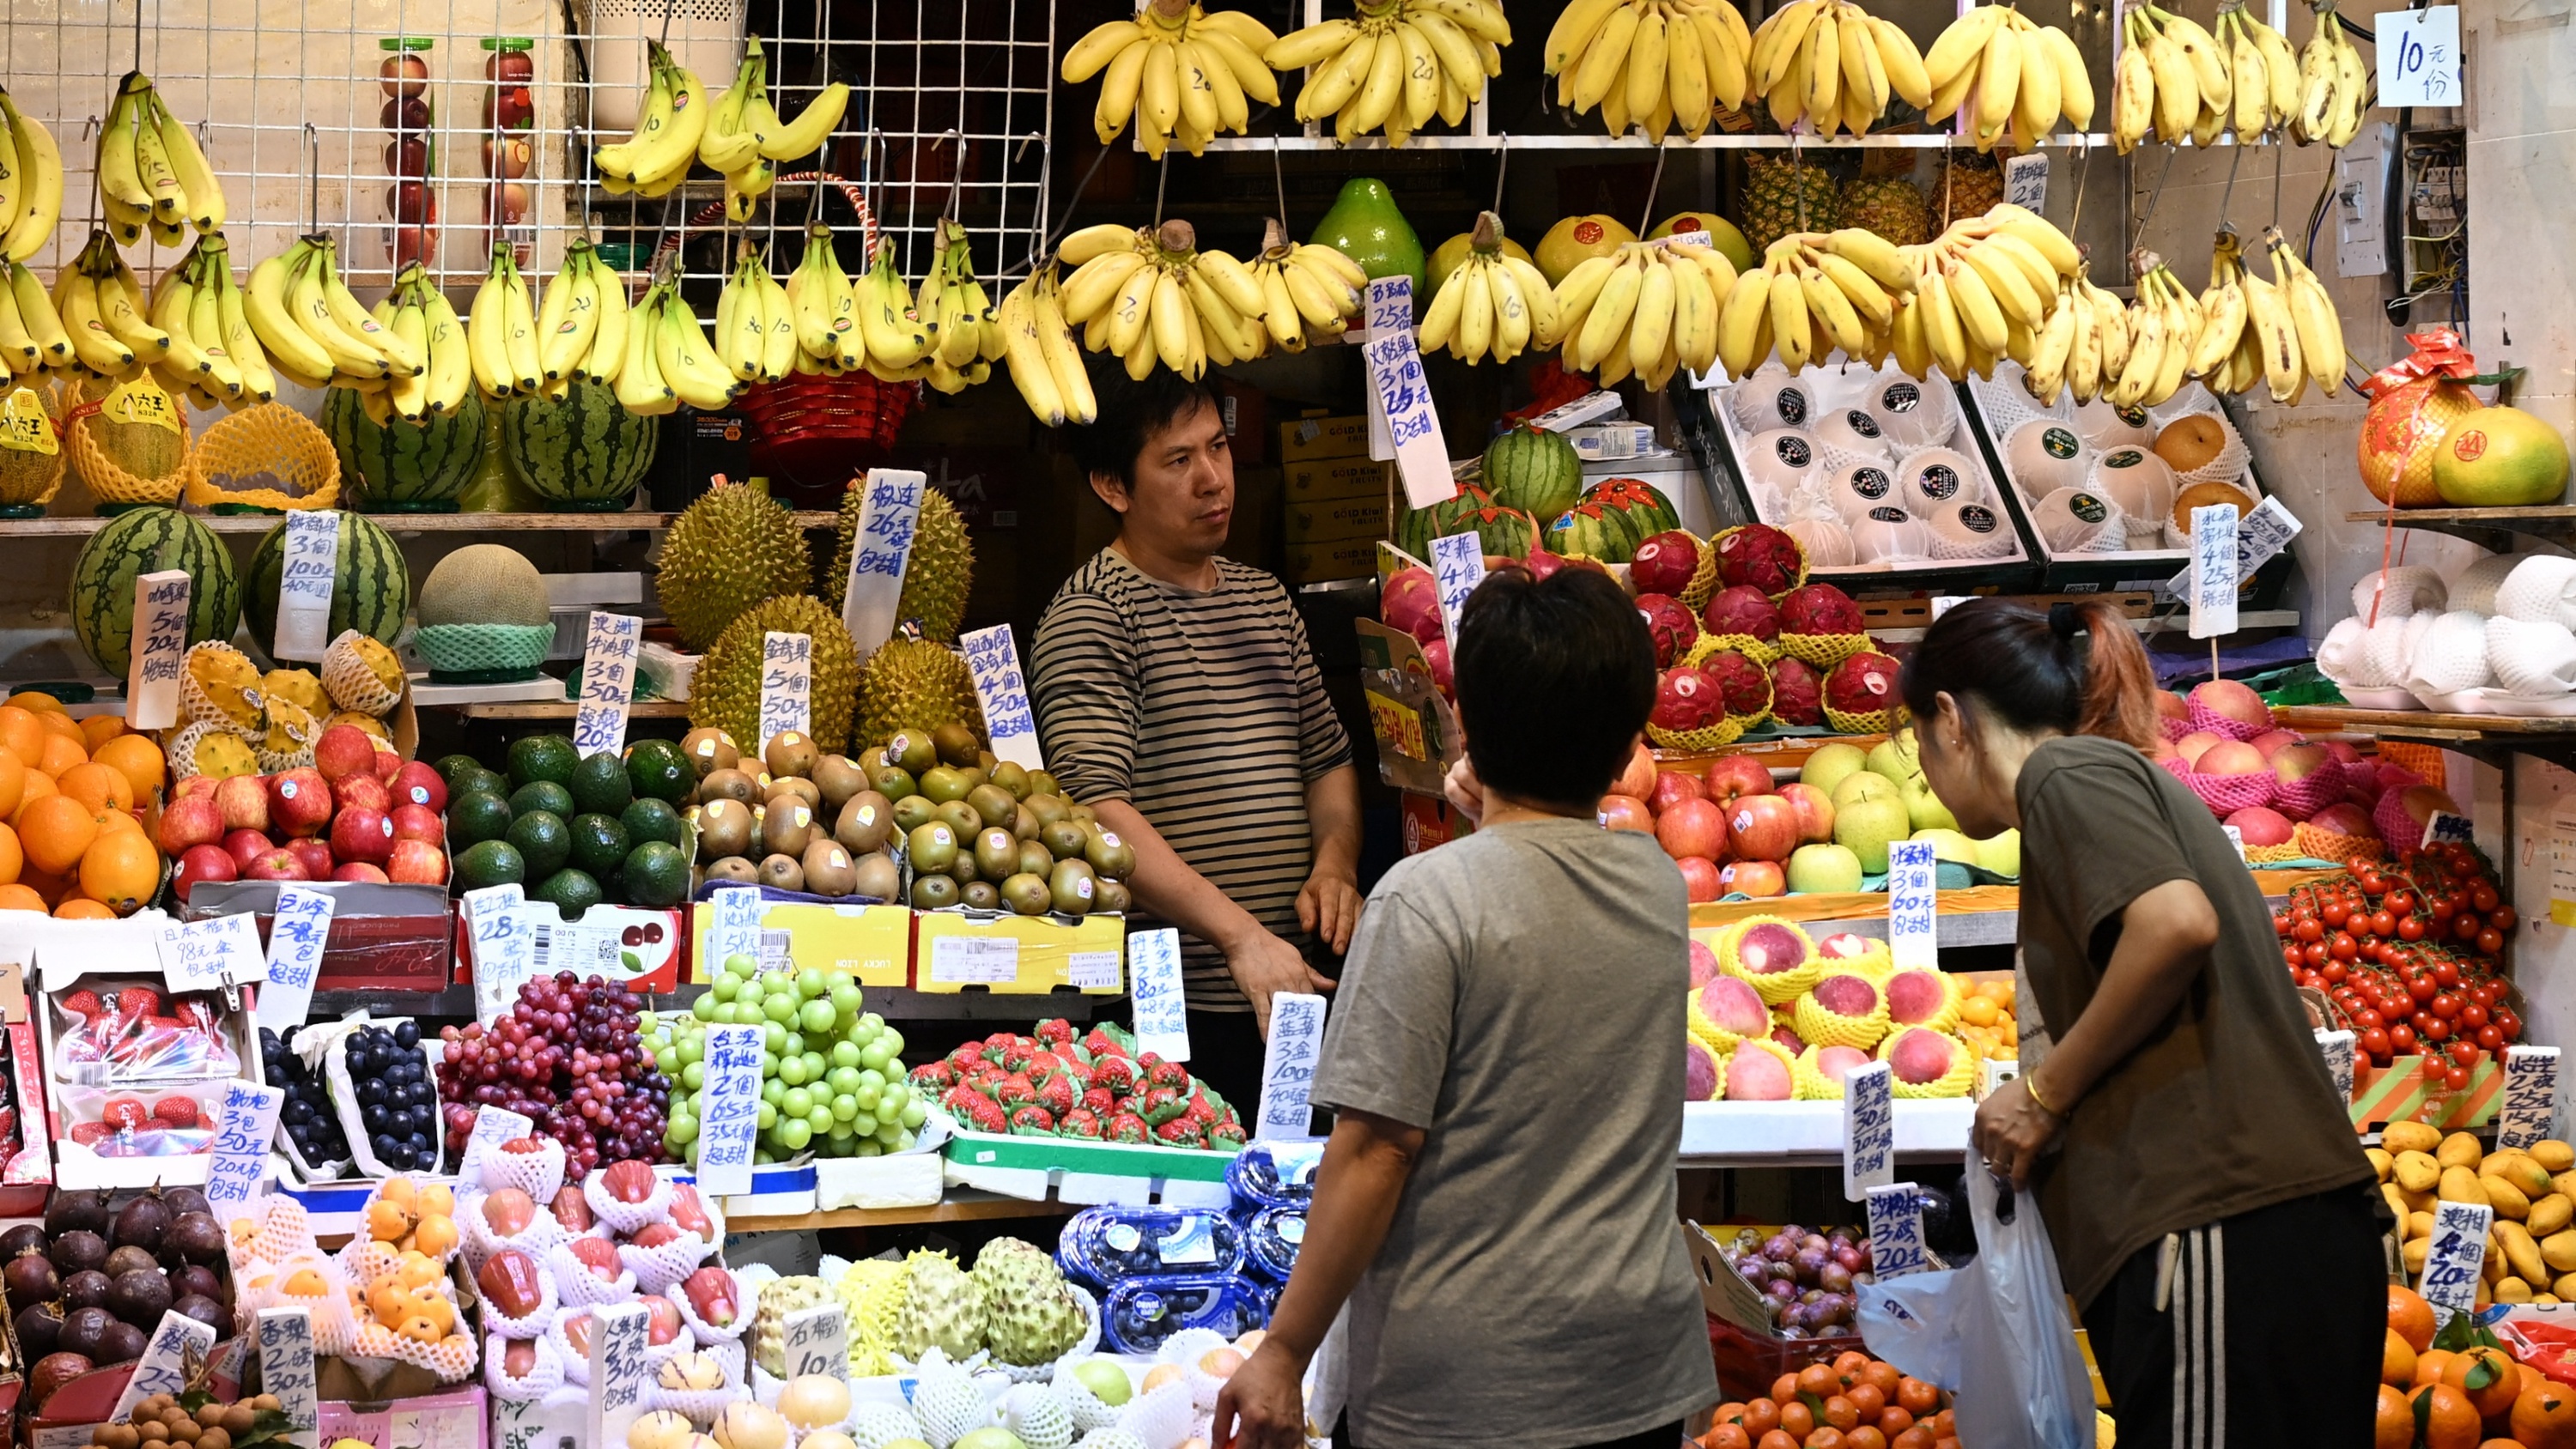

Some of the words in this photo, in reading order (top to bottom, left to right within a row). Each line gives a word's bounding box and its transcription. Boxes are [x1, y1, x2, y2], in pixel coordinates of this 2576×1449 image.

[1411, 55, 1435, 81] 20
[2423, 70, 2451, 101] 份
[643, 112, 660, 134] 10
[114, 299, 133, 318] 13
[1116, 296, 1137, 324] 20
[432, 320, 451, 343] 15
[771, 317, 791, 334] 10
[677, 346, 696, 368] 10
[1376, 358, 1422, 392] 3個
[289, 535, 332, 556] 3個
[2201, 543, 2235, 567] 4個
[1440, 562, 1482, 587] 4個
[150, 610, 186, 634] 5個
[143, 634, 183, 656] 20元
[586, 660, 626, 684] 3個
[762, 669, 809, 694] 5個
[579, 680, 631, 706] 50元
[977, 678, 1022, 696] 4個
[761, 694, 809, 717] 50元
[987, 693, 1030, 718] 50元
[1892, 869, 1929, 890] 3個
[1892, 888, 1937, 911] 60元
[835, 960, 860, 968] LION
[863, 959, 891, 968] LUCKY
[1275, 1040, 1313, 1062] 3盒
[710, 1073, 756, 1097] 2個
[708, 1095, 759, 1122] 65元
[224, 1109, 261, 1134] 3包
[214, 1126, 267, 1157] 50元
[1873, 1246, 1928, 1271] 20元
[1134, 1300, 1160, 1310] JUMBO
[267, 1373, 317, 1395] 30元
